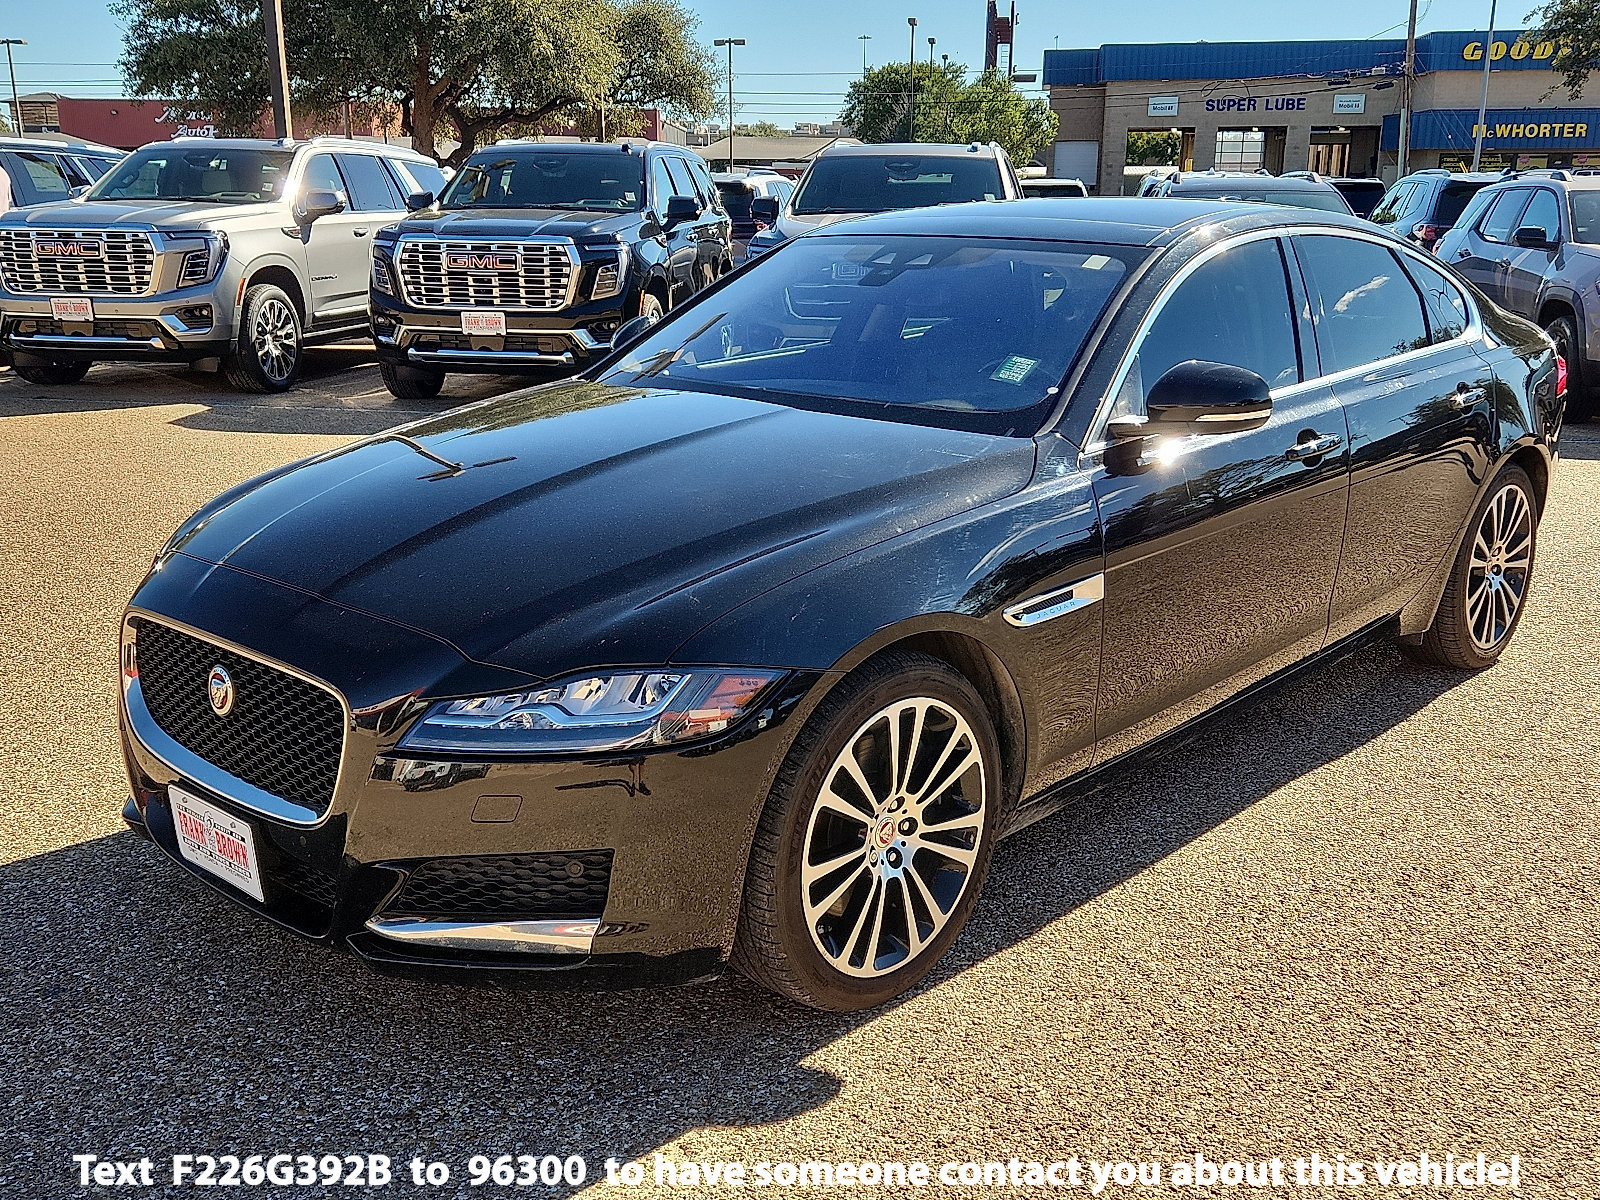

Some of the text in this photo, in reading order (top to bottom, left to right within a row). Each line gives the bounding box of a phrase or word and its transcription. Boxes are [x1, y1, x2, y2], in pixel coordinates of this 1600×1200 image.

[1205, 97, 1307, 112] SUPER LUBE
[1472, 124, 1588, 138] McWHORTER
[36, 242, 99, 255] GMC
[448, 254, 516, 269] GMC
[1036, 600, 1076, 620] JAGUAR
[178, 810, 208, 847] FRANK
[215, 830, 249, 868] BROWN
